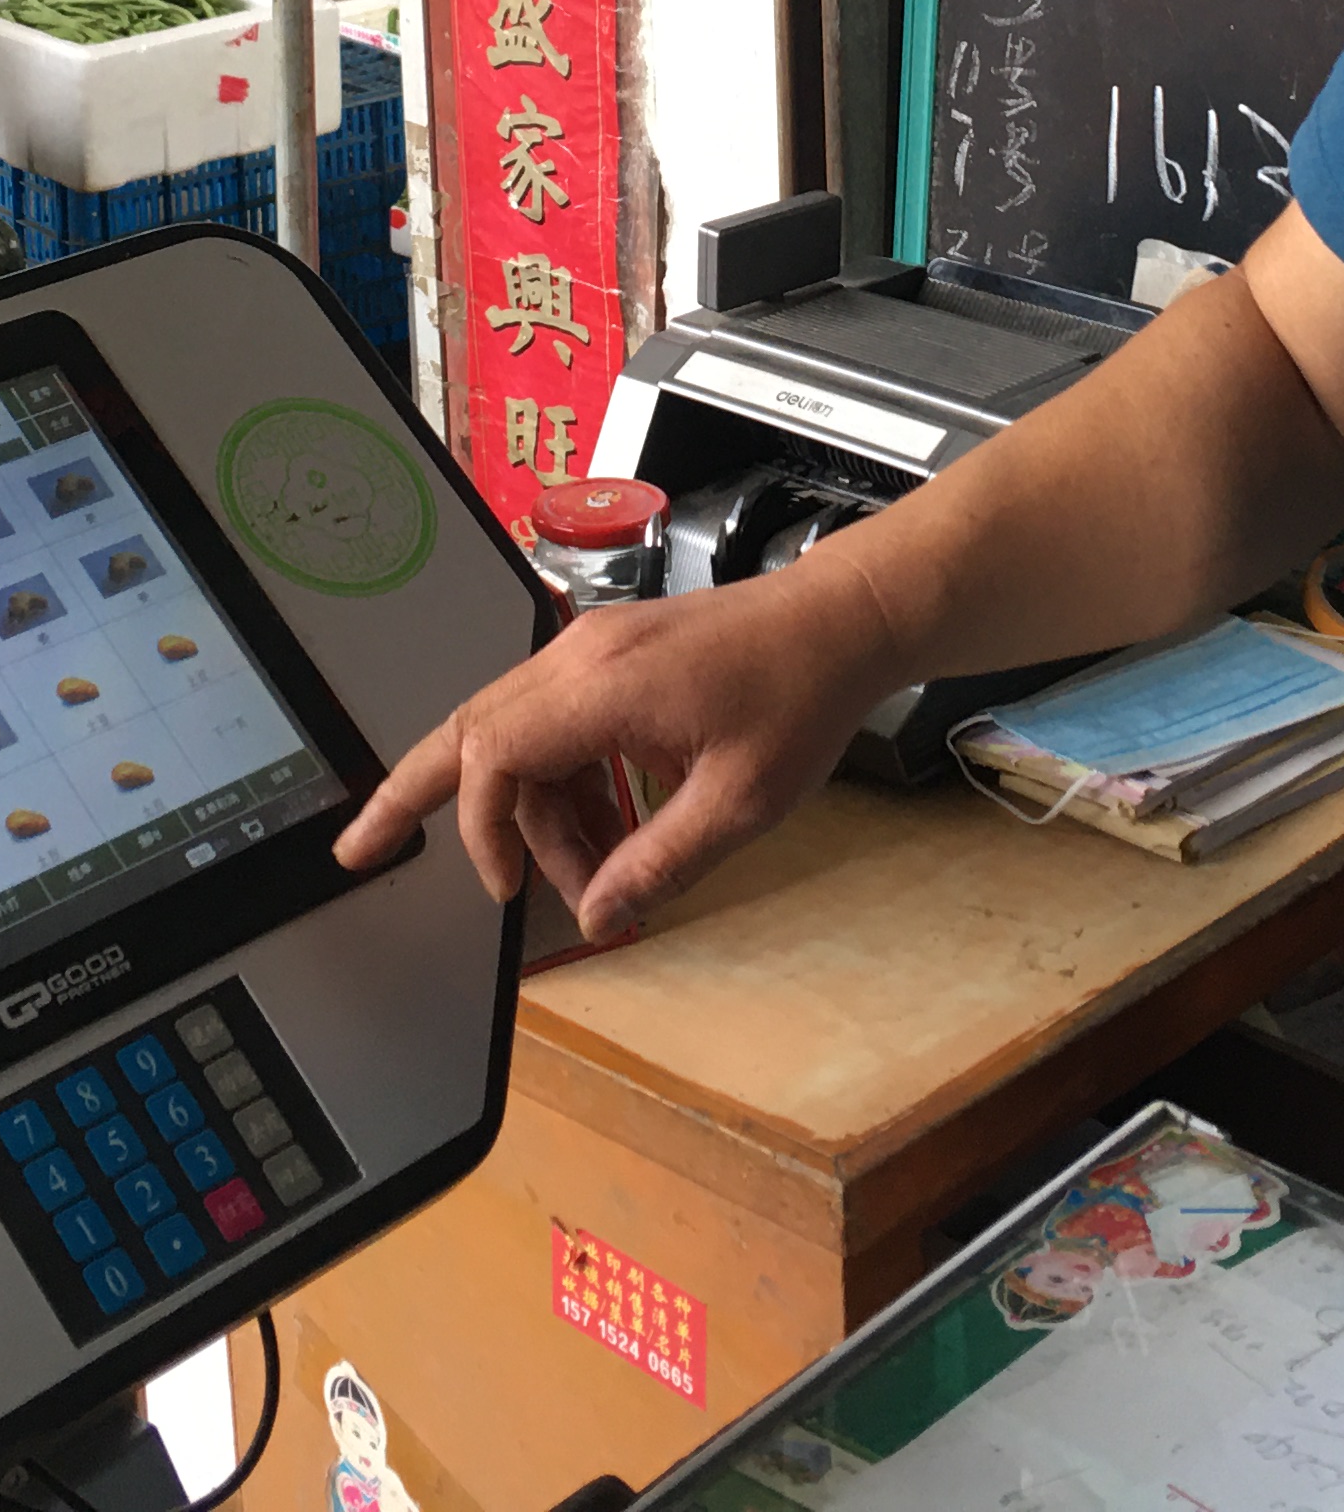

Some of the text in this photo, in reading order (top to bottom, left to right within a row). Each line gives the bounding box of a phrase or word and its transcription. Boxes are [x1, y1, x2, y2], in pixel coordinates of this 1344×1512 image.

[46, 944, 125, 995] GOOD
[56, 960, 132, 1006] PARTNER
[135, 1049, 157, 1077] 9
[75, 1080, 101, 1113] 8
[167, 1097, 189, 1127] 6
[13, 1113, 35, 1145] 7
[107, 1129, 129, 1161] 5
[194, 1145, 218, 1177] 3
[48, 1163, 68, 1192] 4
[134, 1180, 161, 1212] 2
[75, 1215, 97, 1245] 1
[104, 1265, 128, 1298] 0
[561, 1295, 694, 1396] 157 1524 0665
